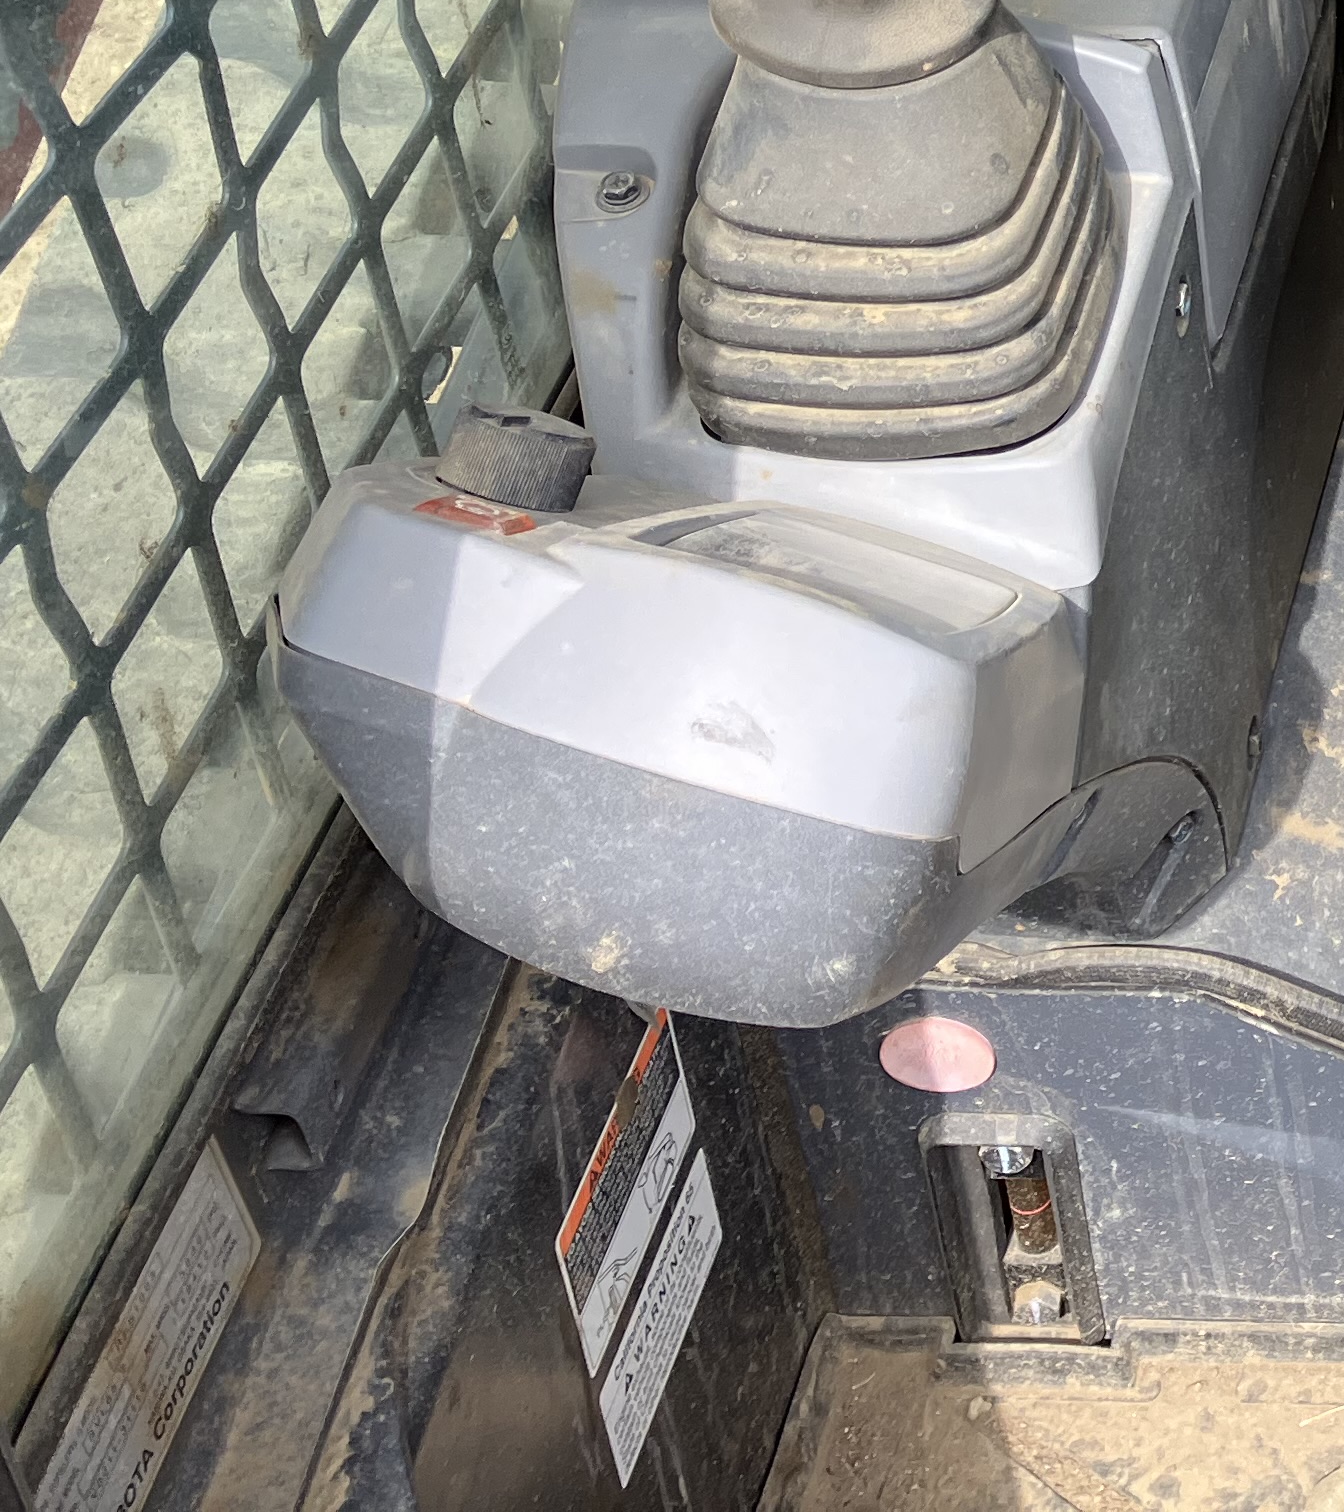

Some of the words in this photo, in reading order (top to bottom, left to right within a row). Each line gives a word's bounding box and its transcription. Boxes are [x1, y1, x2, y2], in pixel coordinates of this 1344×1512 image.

[147, 1276, 233, 1443] Corporation
[613, 1299, 647, 1379] California
[646, 1205, 685, 1297] Proposition
[633, 1236, 686, 1361] WARNING
